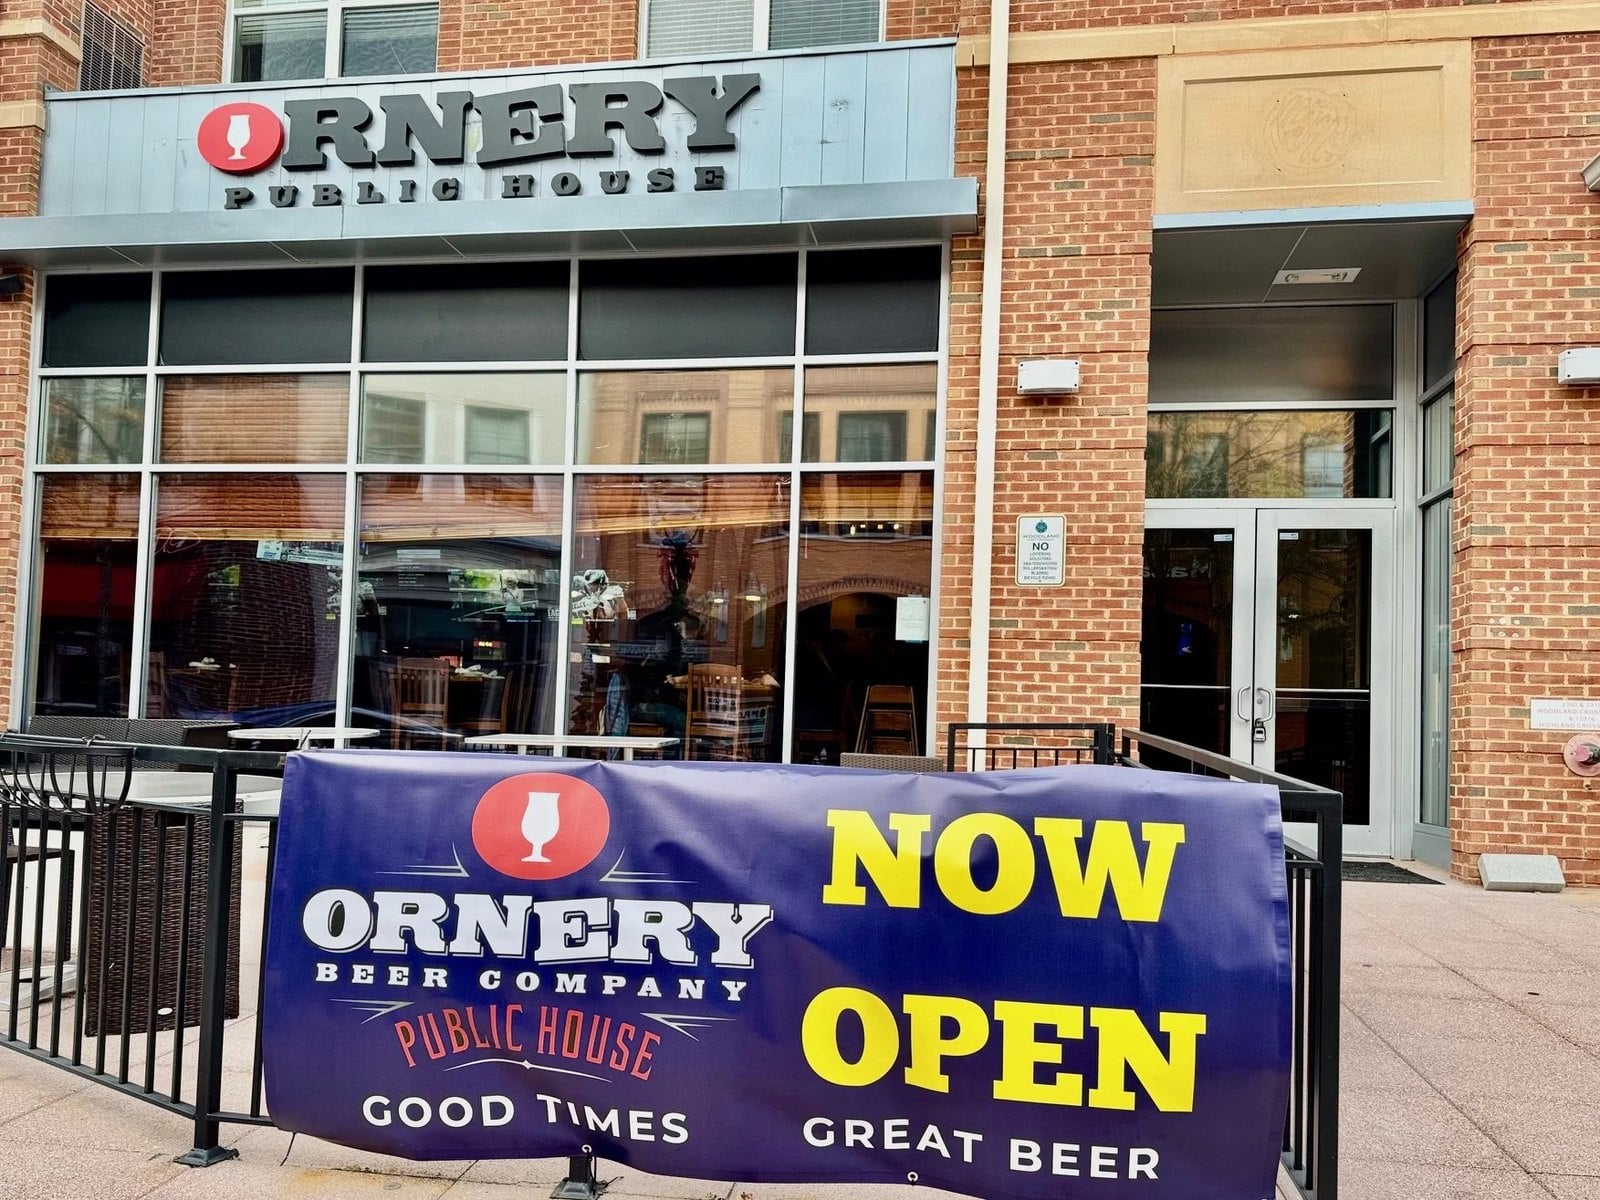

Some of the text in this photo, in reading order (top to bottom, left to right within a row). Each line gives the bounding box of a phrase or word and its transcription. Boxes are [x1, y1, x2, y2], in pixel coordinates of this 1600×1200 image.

[224, 166, 725, 209] PUBLIC HOUSE
[1032, 542, 1049, 551] NO
[823, 809, 1186, 922] NOW
[303, 889, 774, 968] ORNERY
[315, 963, 747, 1001] BEER COMPANY
[395, 1004, 661, 1081] PUBLIC HOUSE
[802, 987, 1207, 1113] OPEN
[362, 1093, 689, 1144] GOOD TIMES
[803, 1117, 1160, 1180] GREAT BEER
